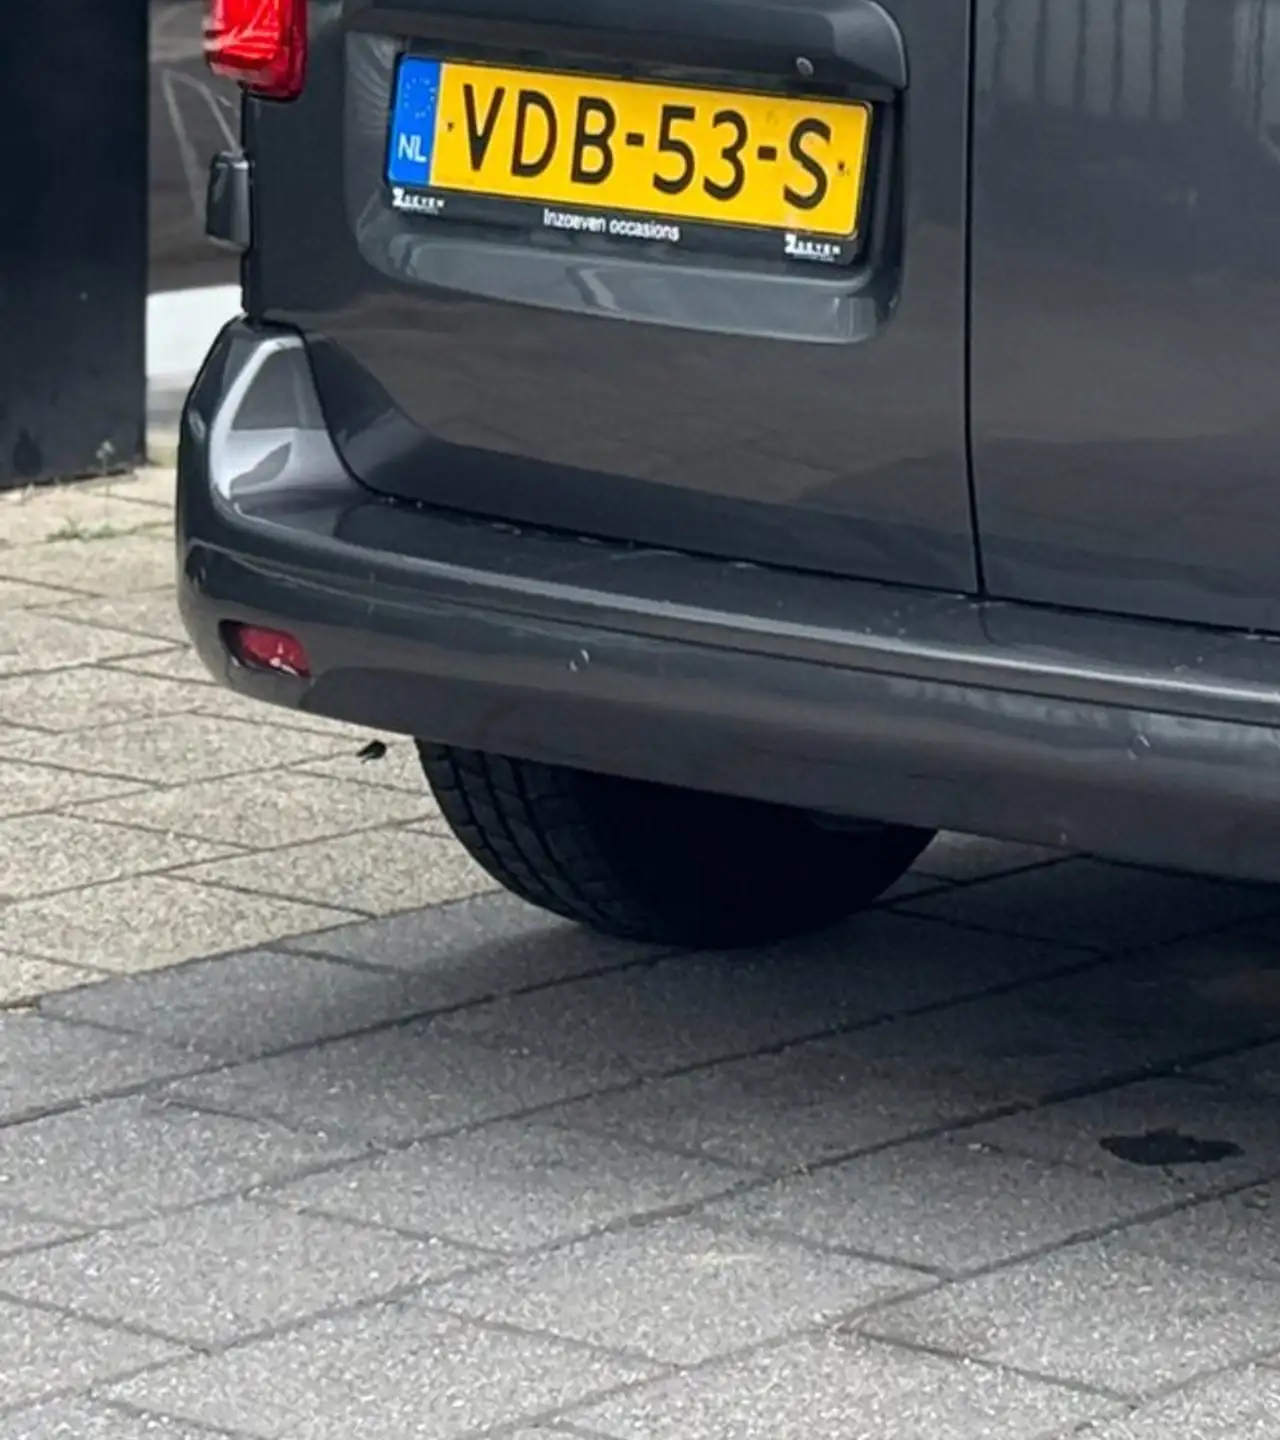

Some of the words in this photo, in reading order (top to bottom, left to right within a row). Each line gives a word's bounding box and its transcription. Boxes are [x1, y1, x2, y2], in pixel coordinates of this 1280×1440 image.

[398, 132, 428, 164] NL
[462, 83, 833, 210] VDB-53-S
[609, 218, 680, 243] occasions
